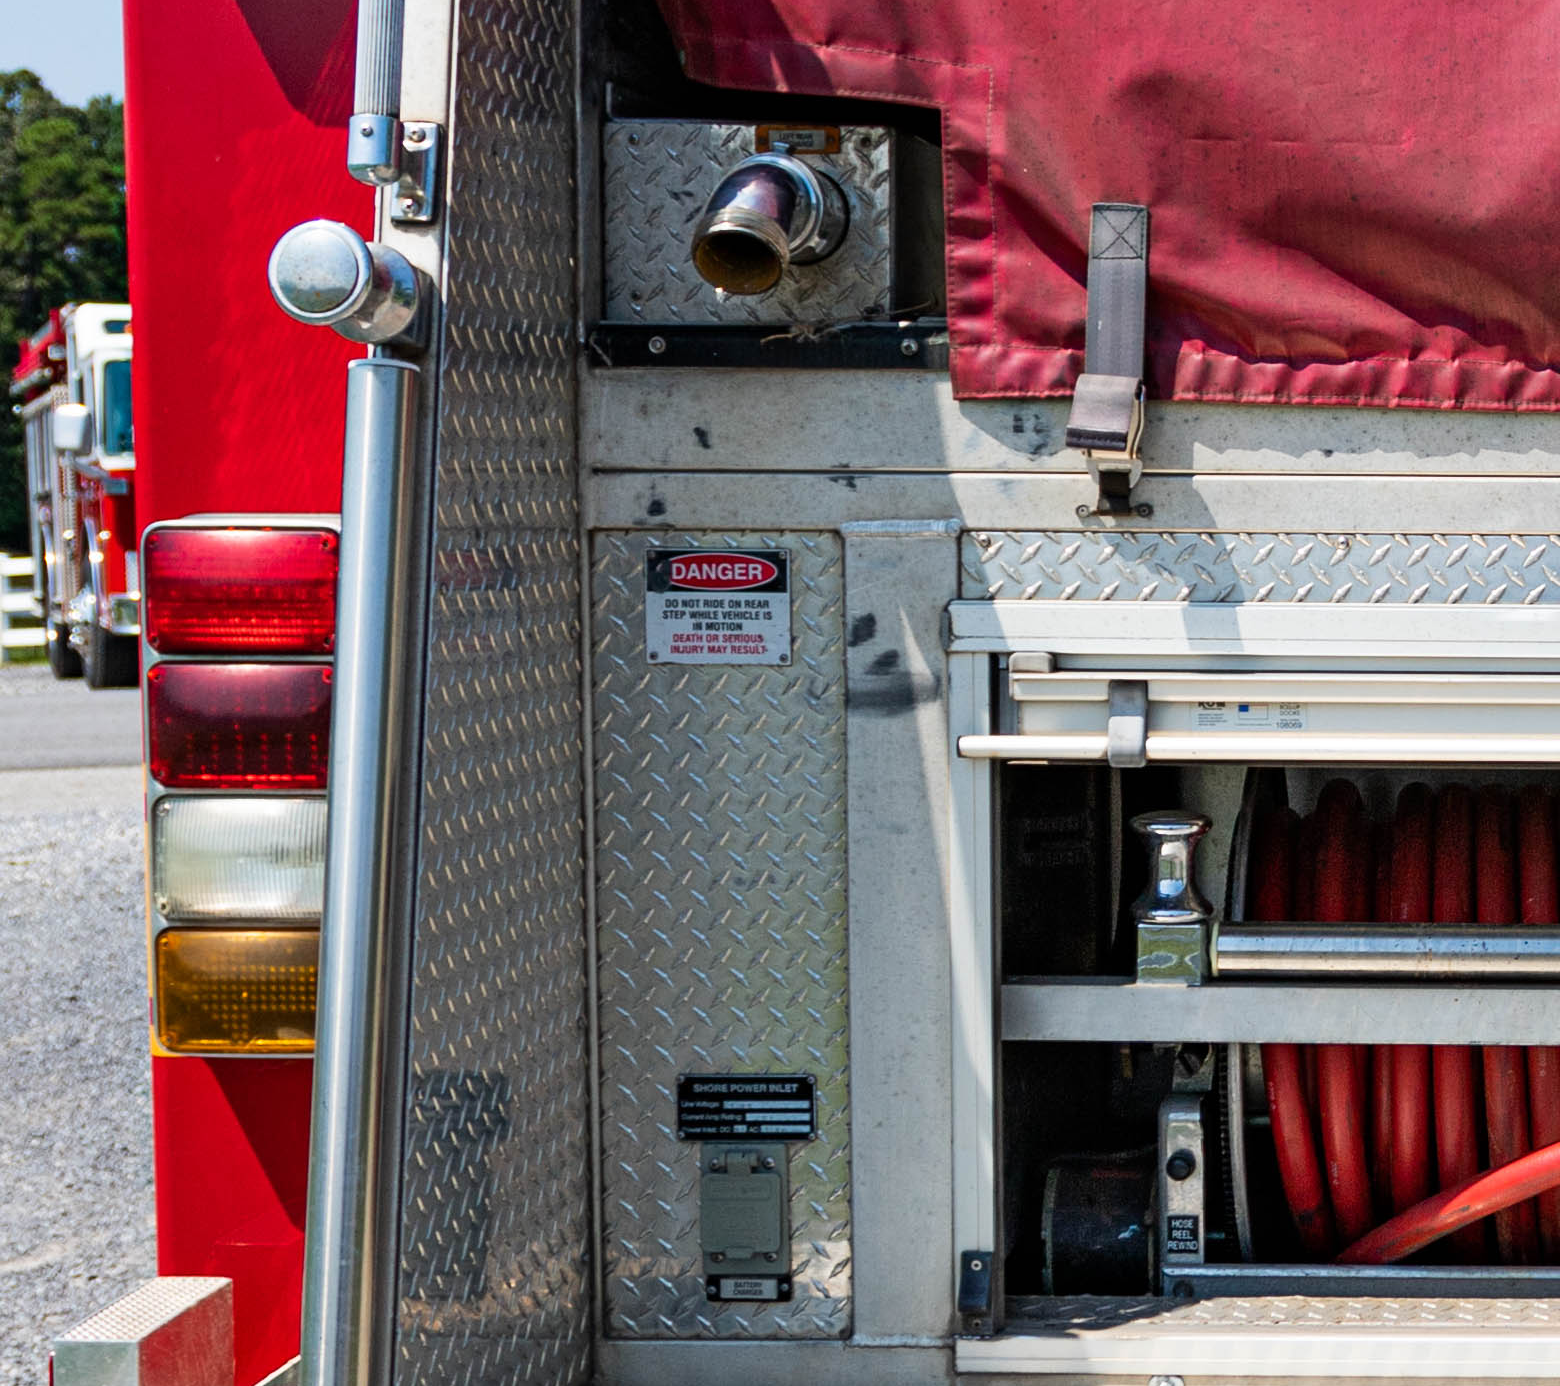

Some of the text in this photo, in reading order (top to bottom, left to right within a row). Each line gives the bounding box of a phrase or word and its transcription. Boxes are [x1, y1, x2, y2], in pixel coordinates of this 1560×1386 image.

[671, 563, 763, 581] DANGER
[665, 599, 770, 609] DO NOT RIDE ON REAR
[662, 610, 773, 621] STEP WHILE VEHICLE IS
[692, 622, 743, 631] IN MOTION
[672, 633, 764, 644] DEATH OR SERIOUS
[670, 644, 705, 655] INJURY
[707, 644, 728, 655] MAY
[693, 1083, 798, 1093] SHORE POWER INLET
[1171, 1219, 1193, 1229] HOSE
[1172, 1230, 1193, 1240] REEL
